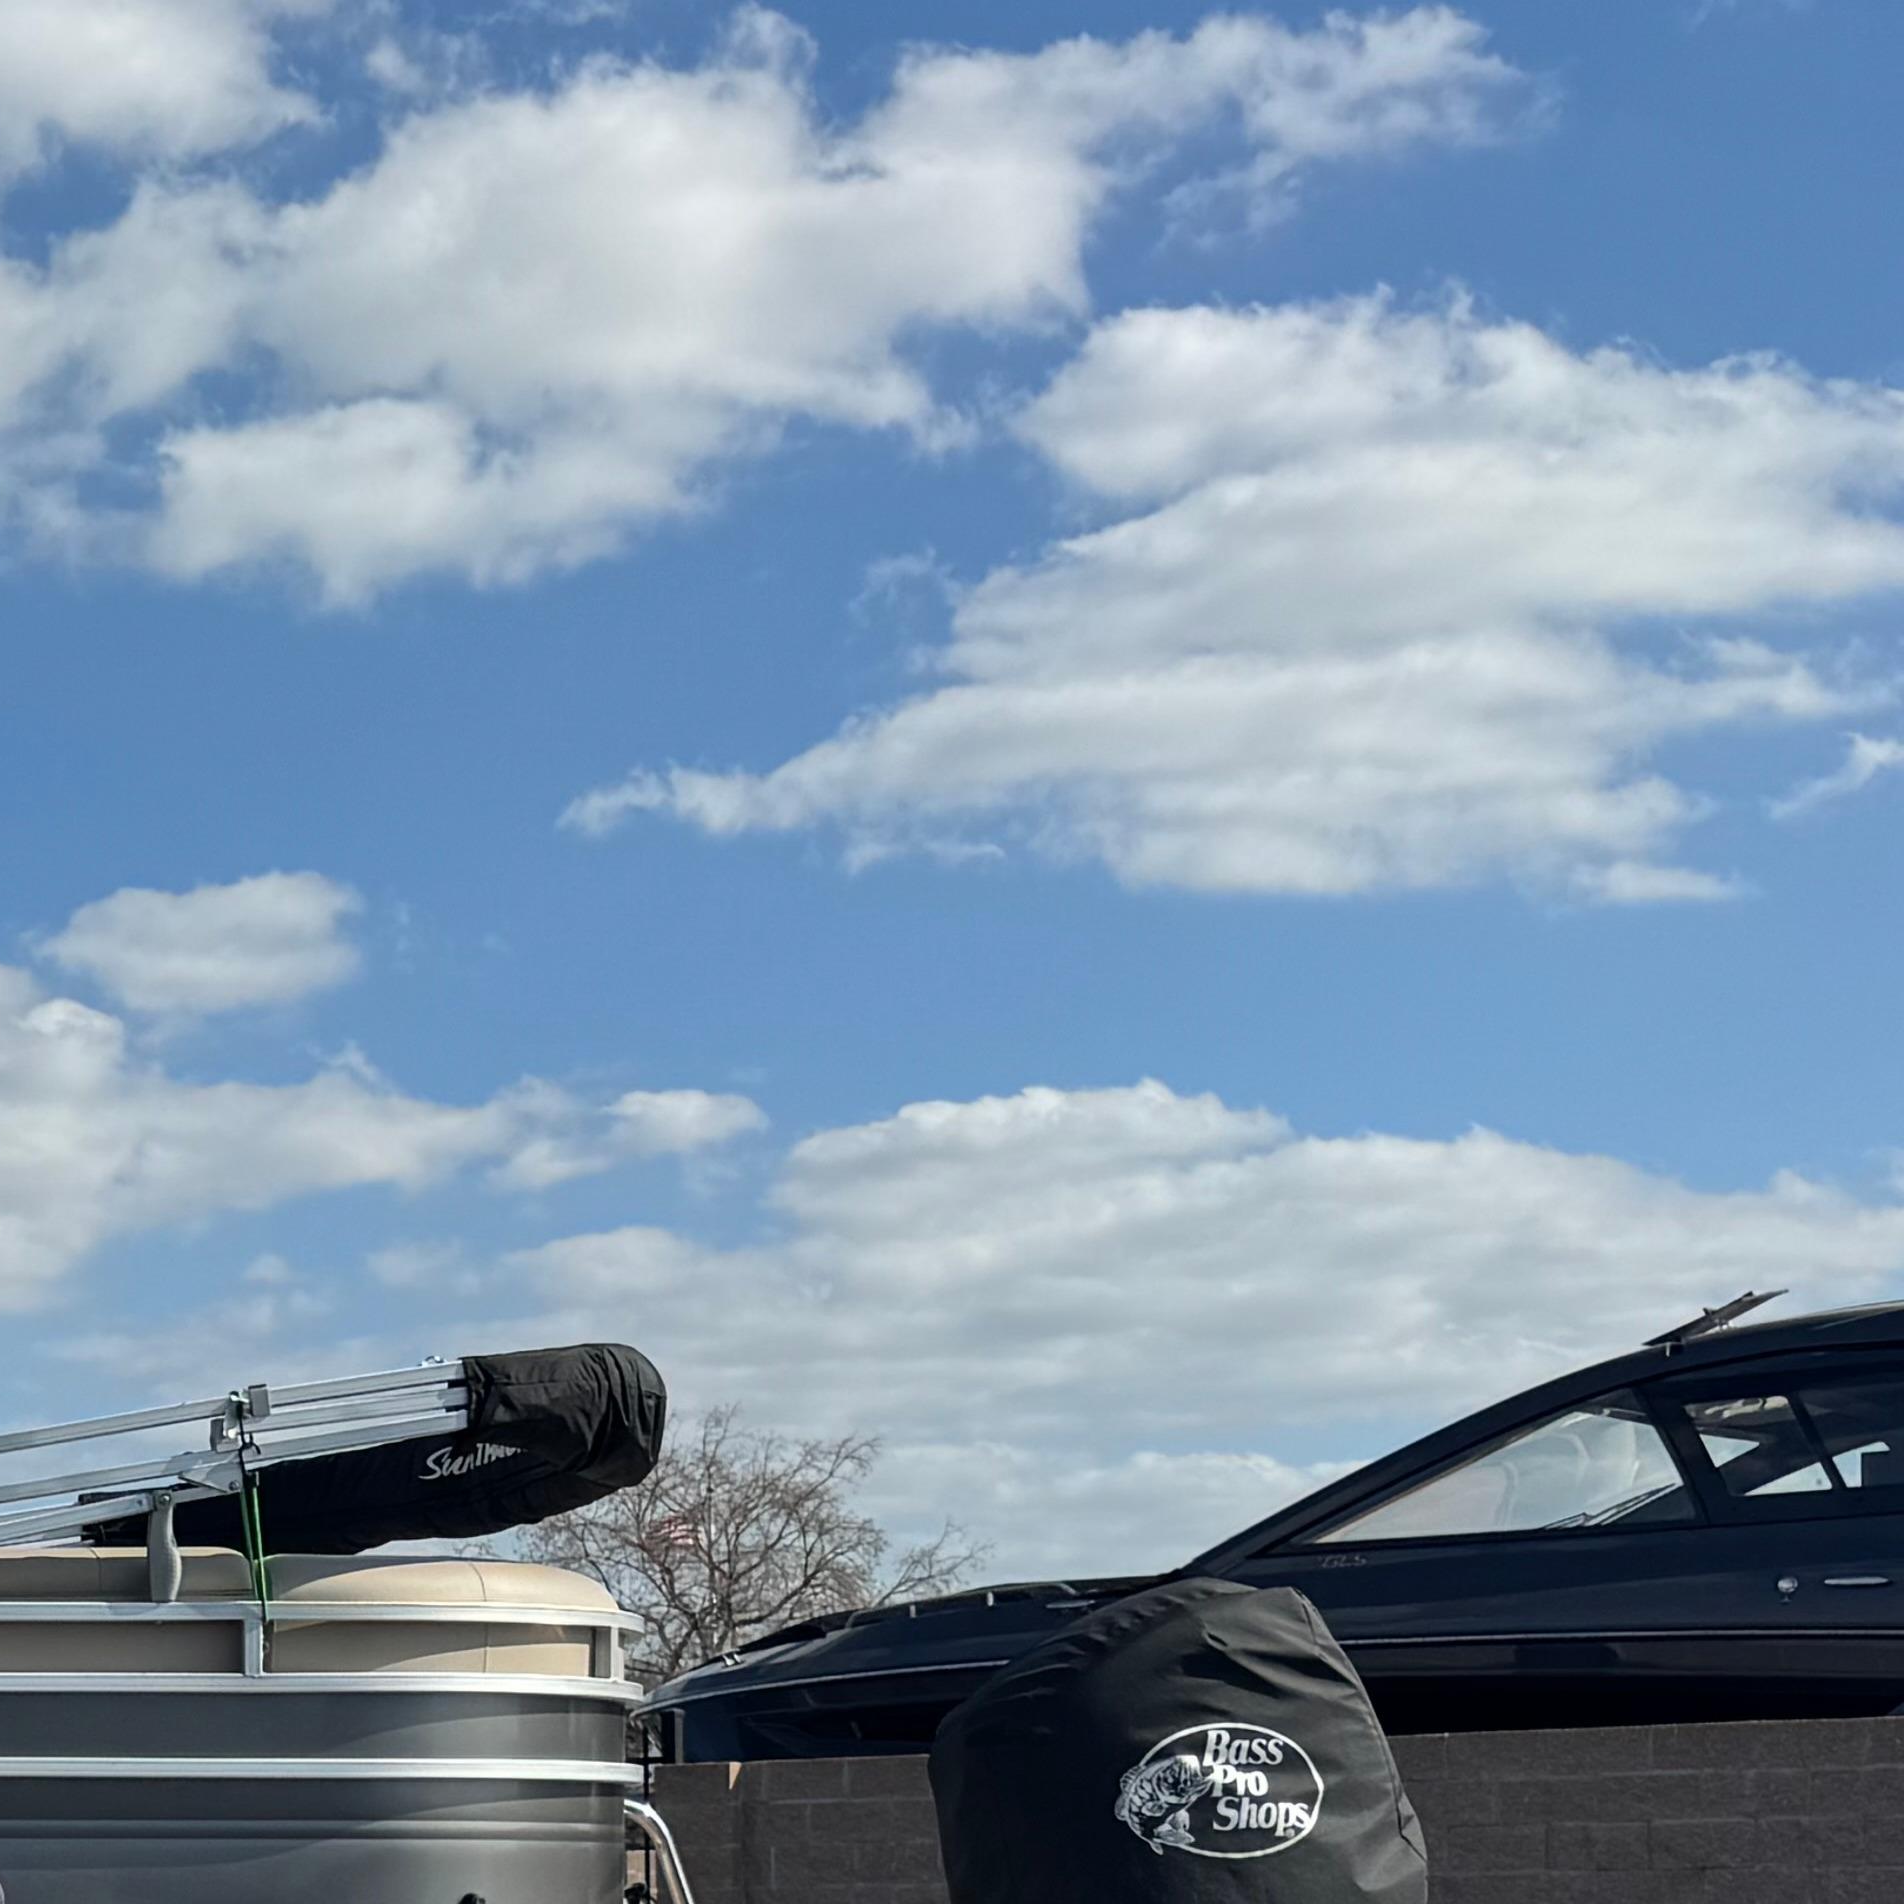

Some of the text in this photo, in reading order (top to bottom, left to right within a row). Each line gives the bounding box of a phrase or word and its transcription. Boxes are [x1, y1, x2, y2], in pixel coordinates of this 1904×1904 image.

[1202, 1729, 1284, 1766] Bass
[1210, 1763, 1270, 1797] Pro
[1212, 1796, 1310, 1837] Shops
